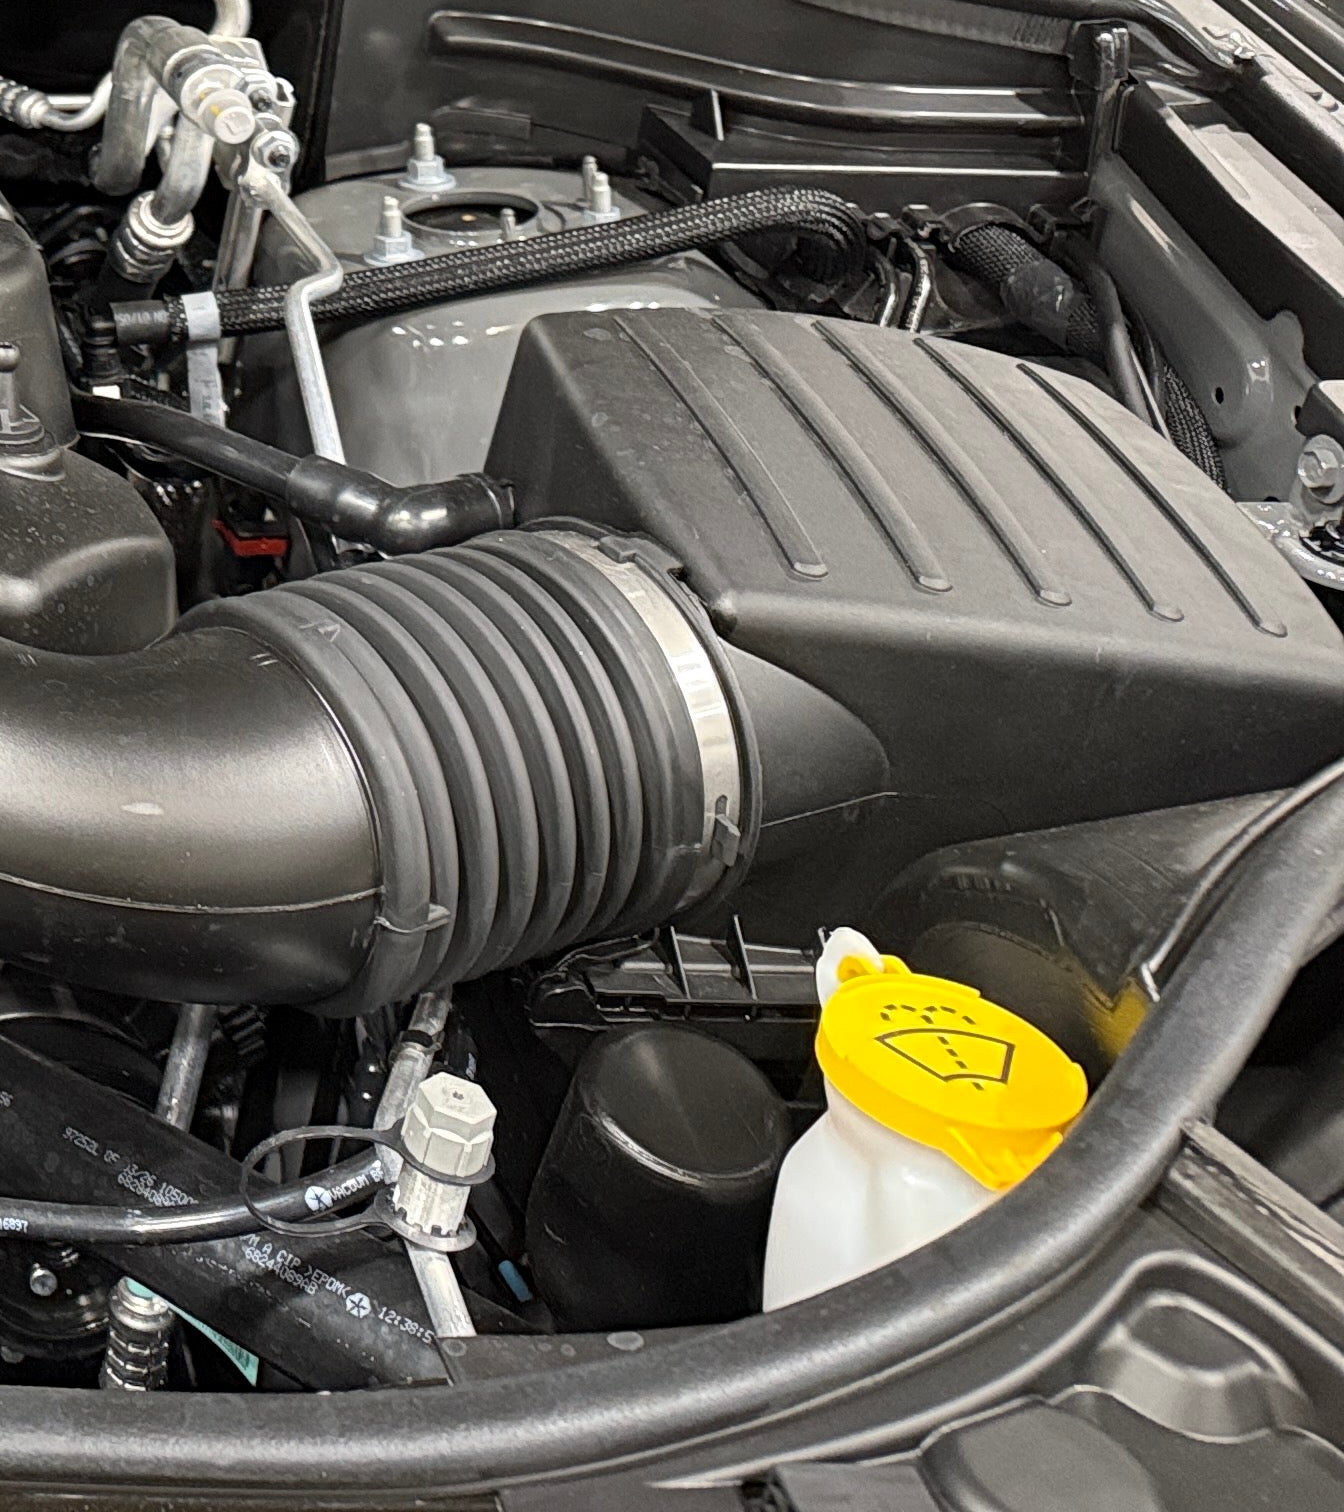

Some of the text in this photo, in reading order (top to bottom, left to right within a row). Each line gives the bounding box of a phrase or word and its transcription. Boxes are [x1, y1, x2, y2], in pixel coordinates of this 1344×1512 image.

[261, 1240, 274, 1254] A
[275, 1249, 301, 1270] CIP
[376, 1305, 436, 1345] 12:38:5
